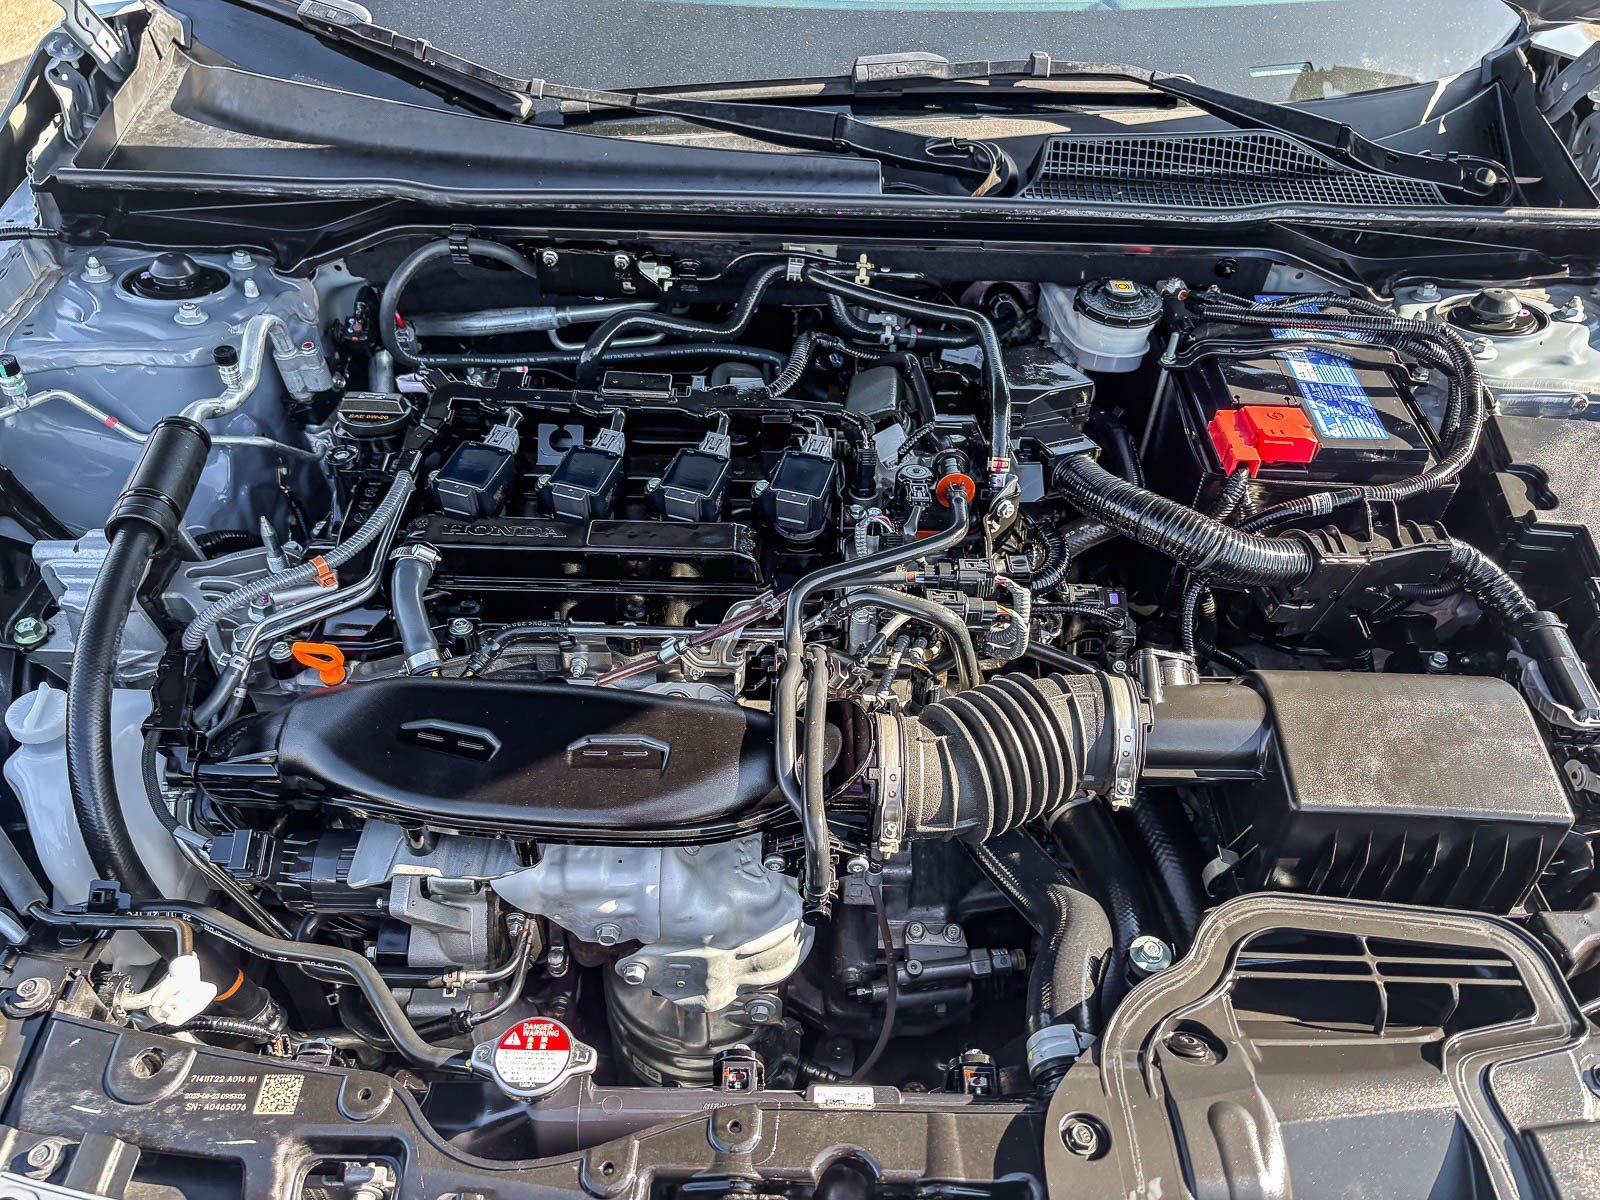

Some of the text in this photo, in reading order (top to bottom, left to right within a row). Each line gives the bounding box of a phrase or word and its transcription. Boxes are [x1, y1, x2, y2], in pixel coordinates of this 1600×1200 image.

[441, 523, 567, 538] HONDA
[227, 1075, 246, 1083] A014
[184, 1102, 247, 1111] SN: A0465076
